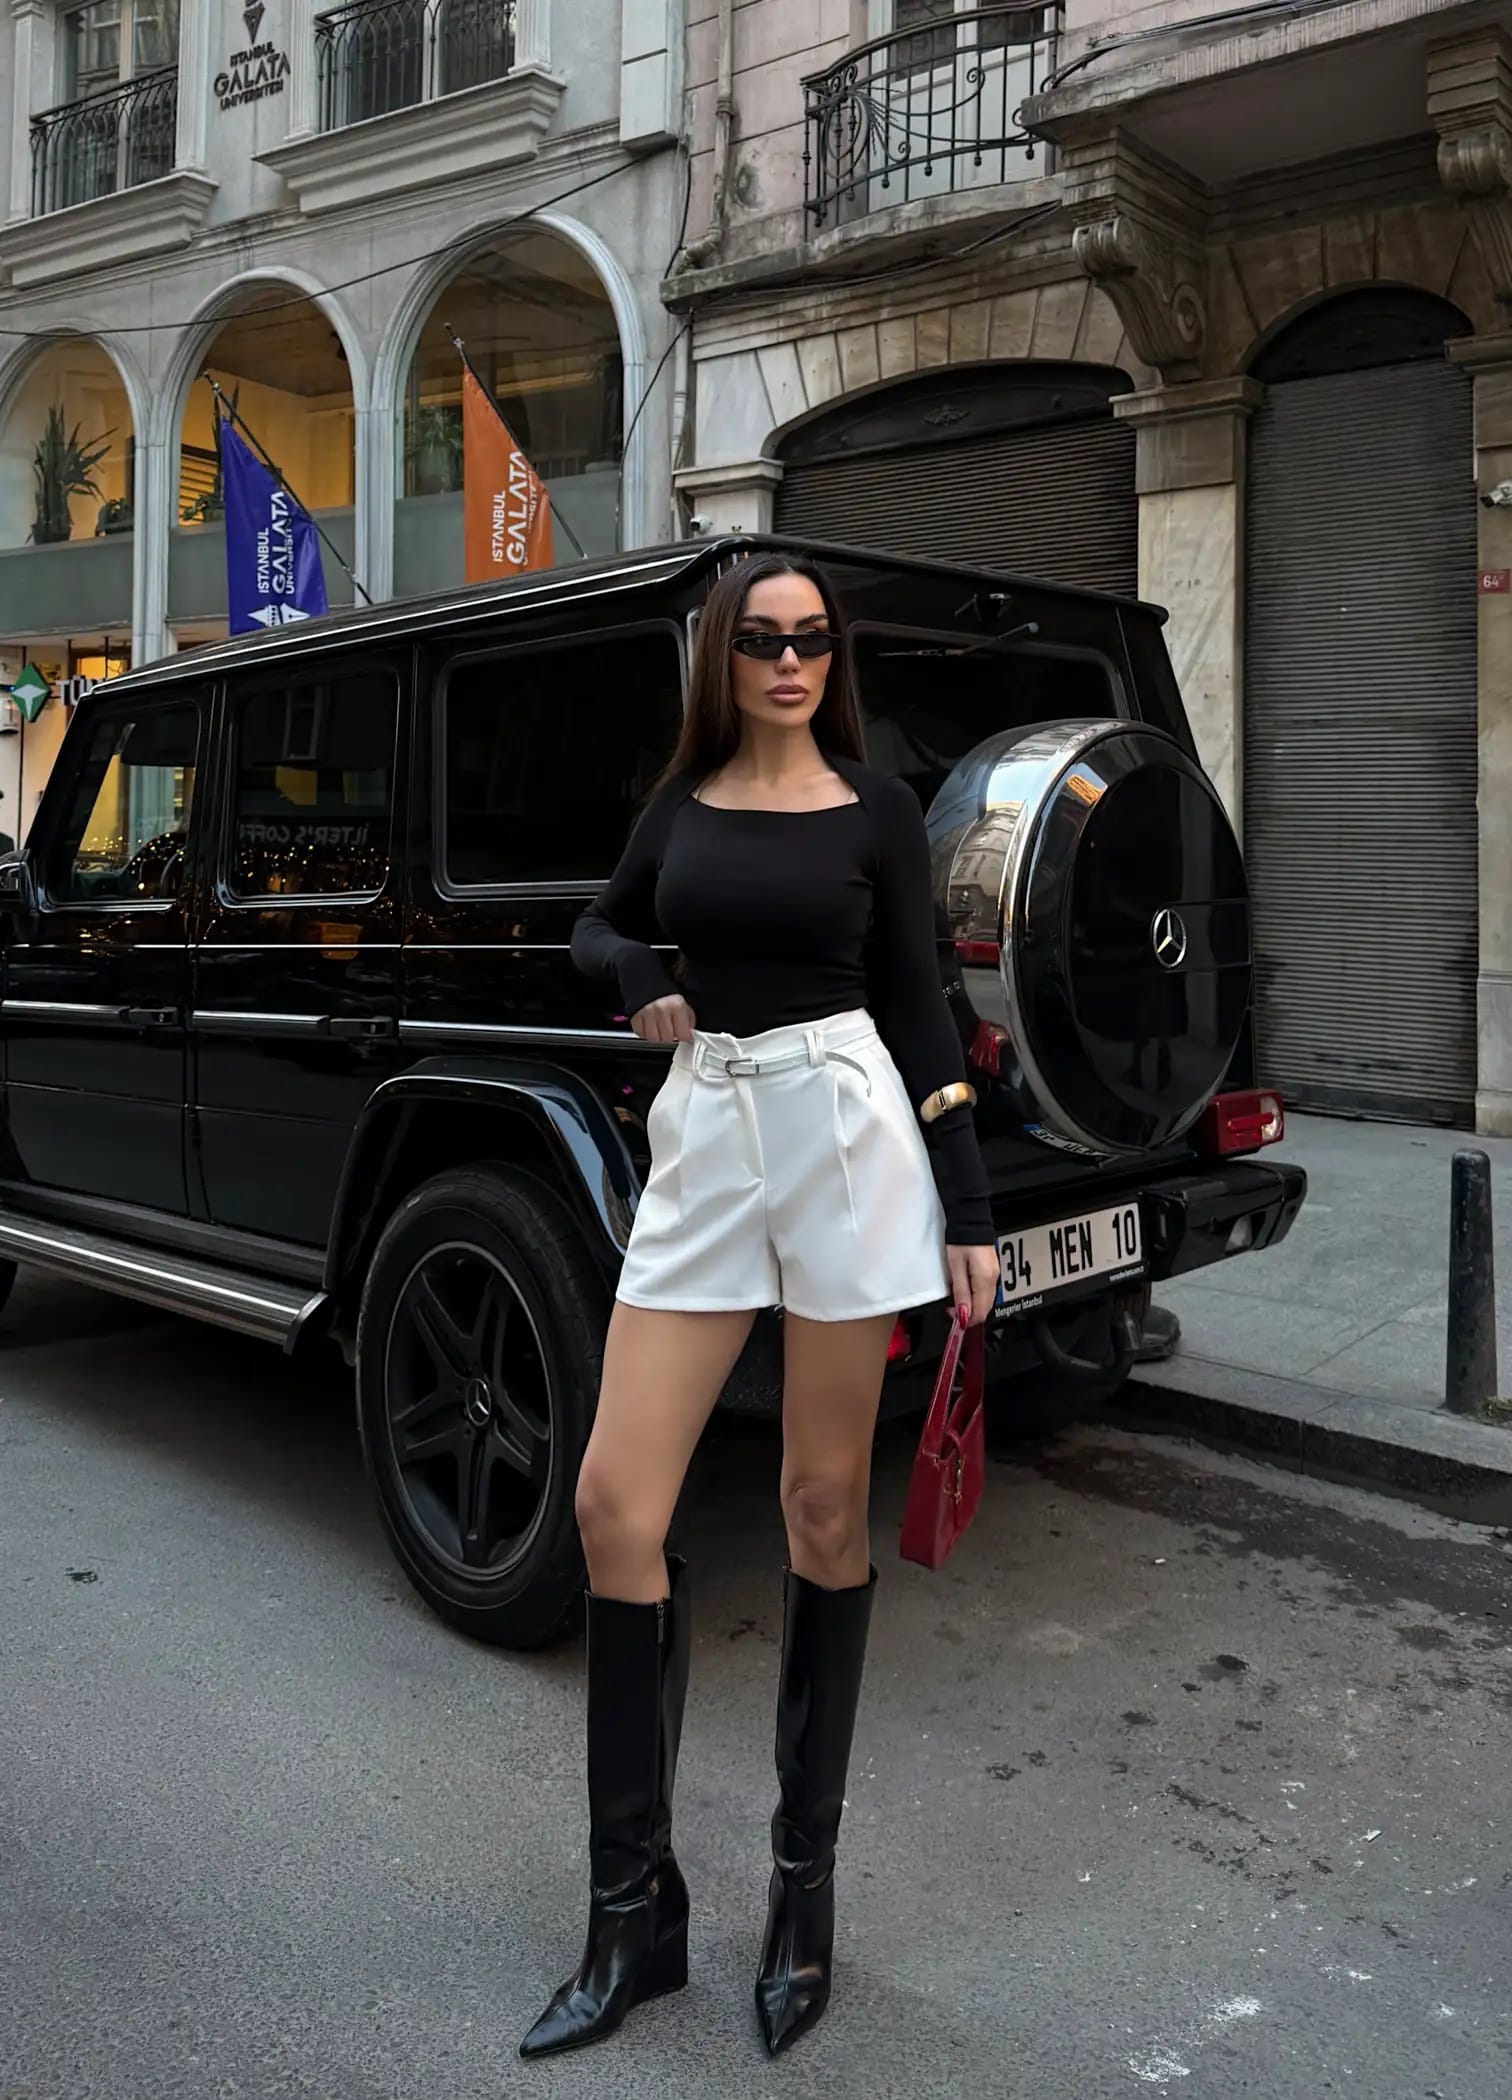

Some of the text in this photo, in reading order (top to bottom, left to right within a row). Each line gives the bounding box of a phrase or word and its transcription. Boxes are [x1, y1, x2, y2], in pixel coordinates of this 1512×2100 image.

[214, 51, 291, 97] GALATA
[271, 491, 289, 593] GALATA
[491, 490, 506, 562] ISTANBUL
[506, 451, 528, 564] GALATA
[257, 528, 270, 593] ISTANBUL
[1001, 1209, 1136, 1292] 34 MEN 10
